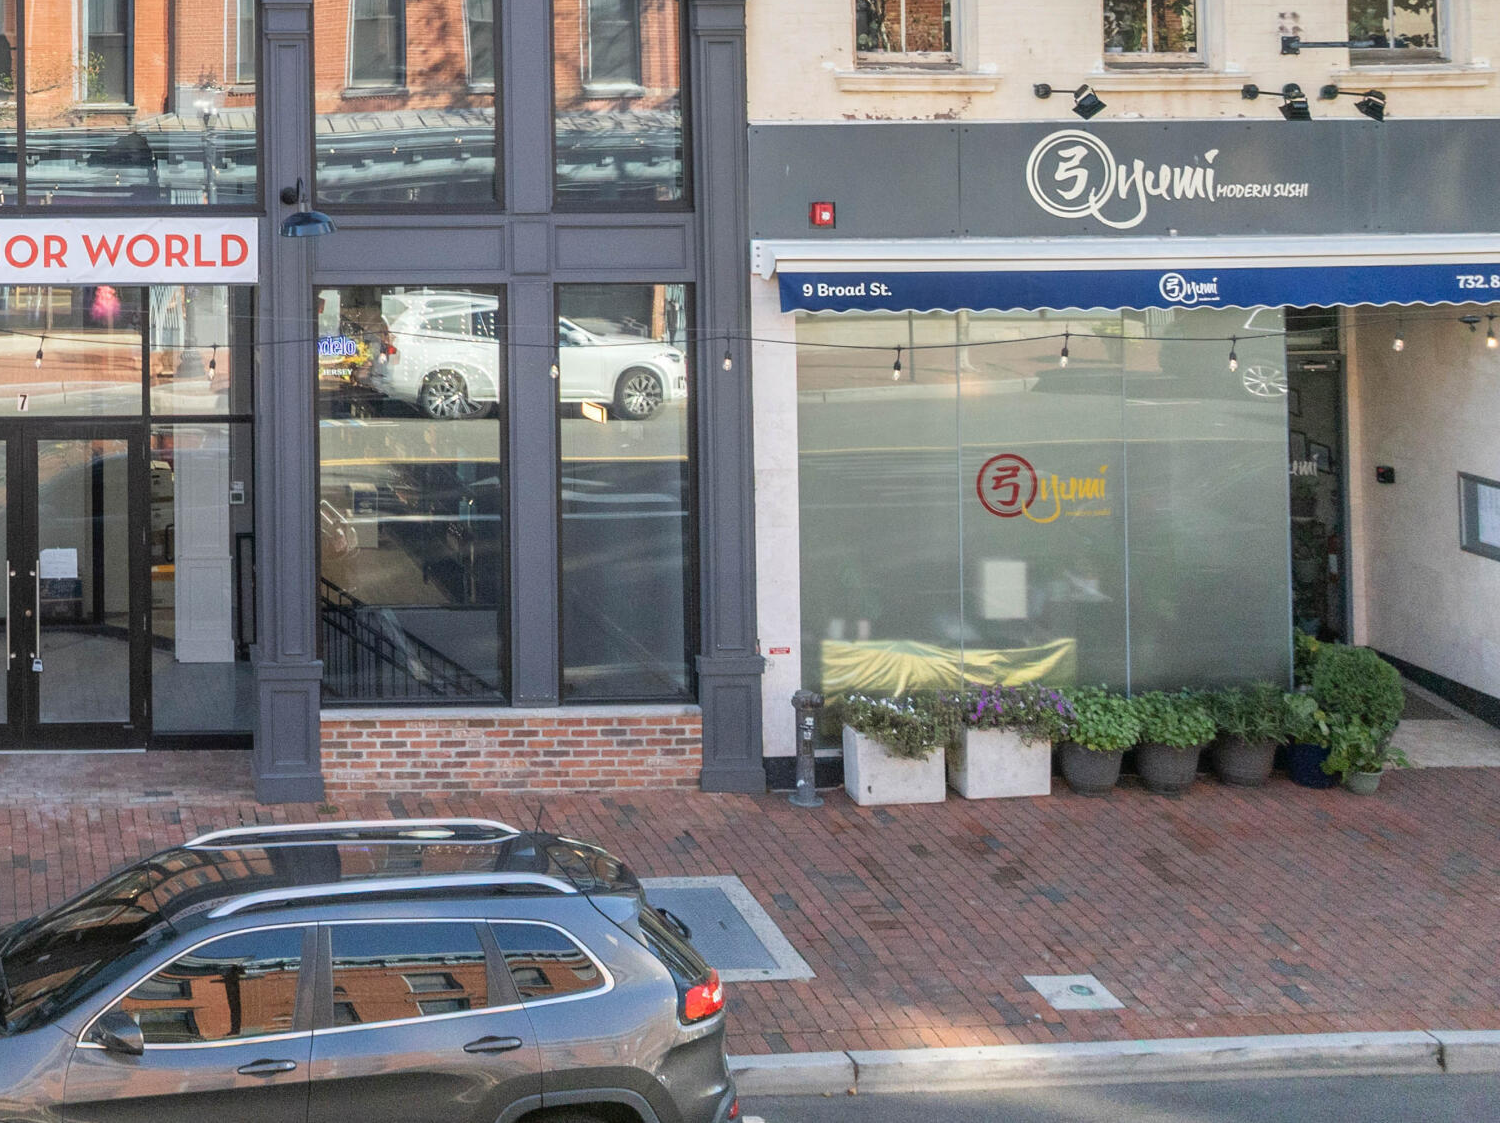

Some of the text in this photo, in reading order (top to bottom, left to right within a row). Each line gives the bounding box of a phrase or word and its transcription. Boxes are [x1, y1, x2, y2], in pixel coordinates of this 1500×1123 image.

[1089, 149, 1309, 229] yumi MODERN SUSHI
[81, 234, 249, 269] WORLD
[802, 282, 892, 297] 9 Broad St.
[20, 394, 28, 410] 7
[1022, 465, 1108, 524] yumi
